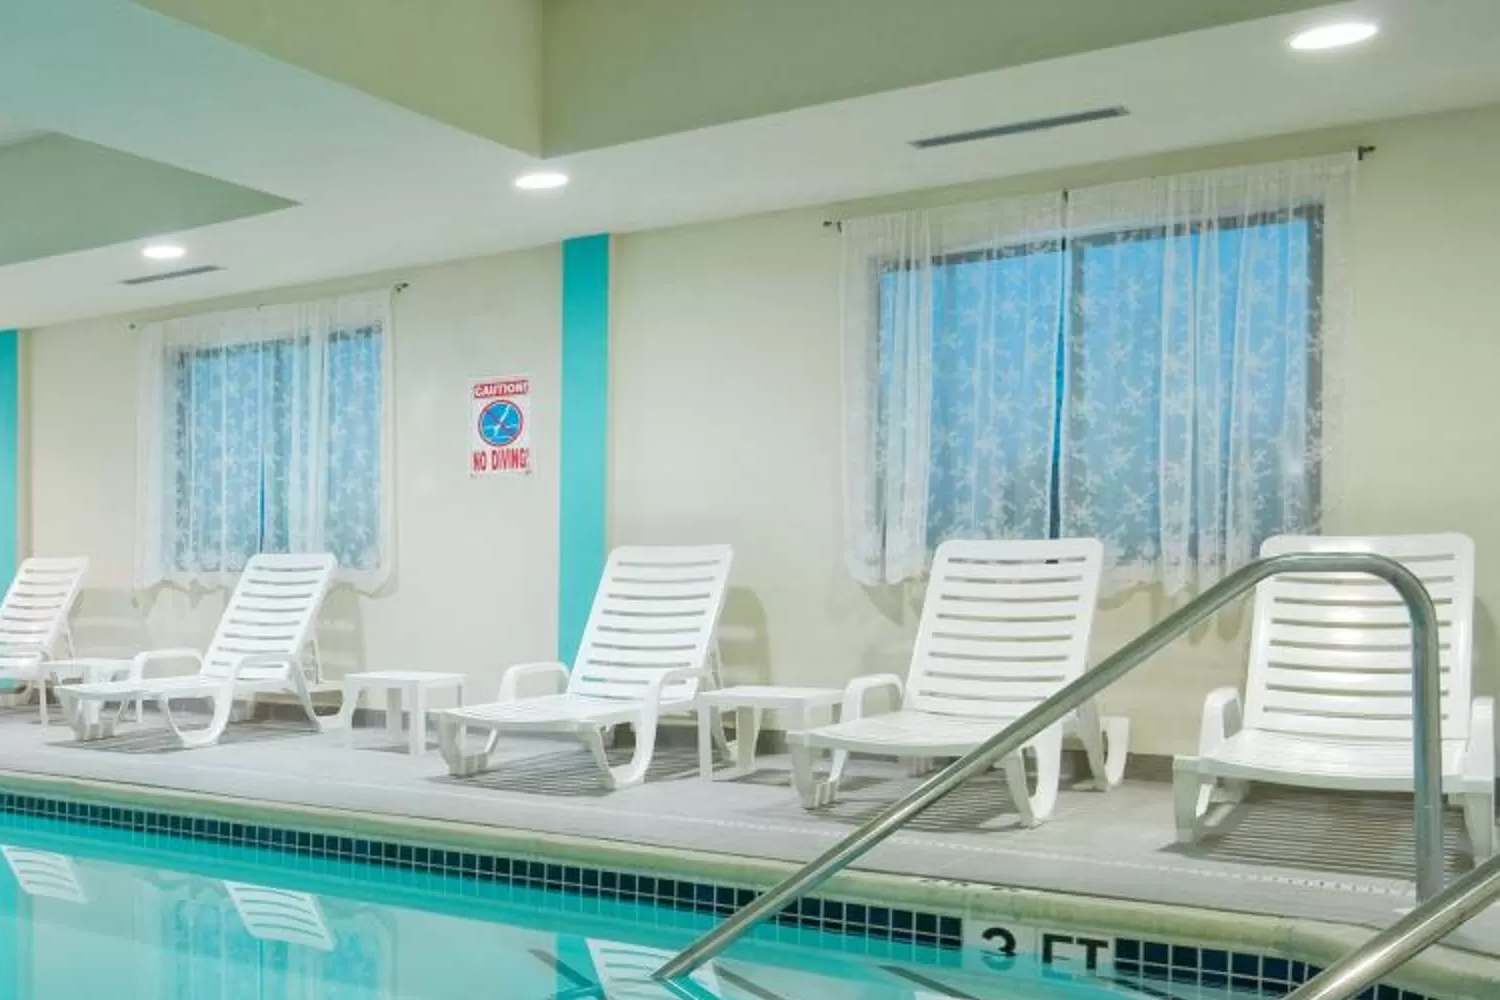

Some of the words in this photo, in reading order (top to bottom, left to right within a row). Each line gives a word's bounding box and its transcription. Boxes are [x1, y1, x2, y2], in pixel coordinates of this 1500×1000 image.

[473, 451, 487, 471] NO
[982, 927, 1017, 962] 3
[1043, 933, 1109, 971] FT
